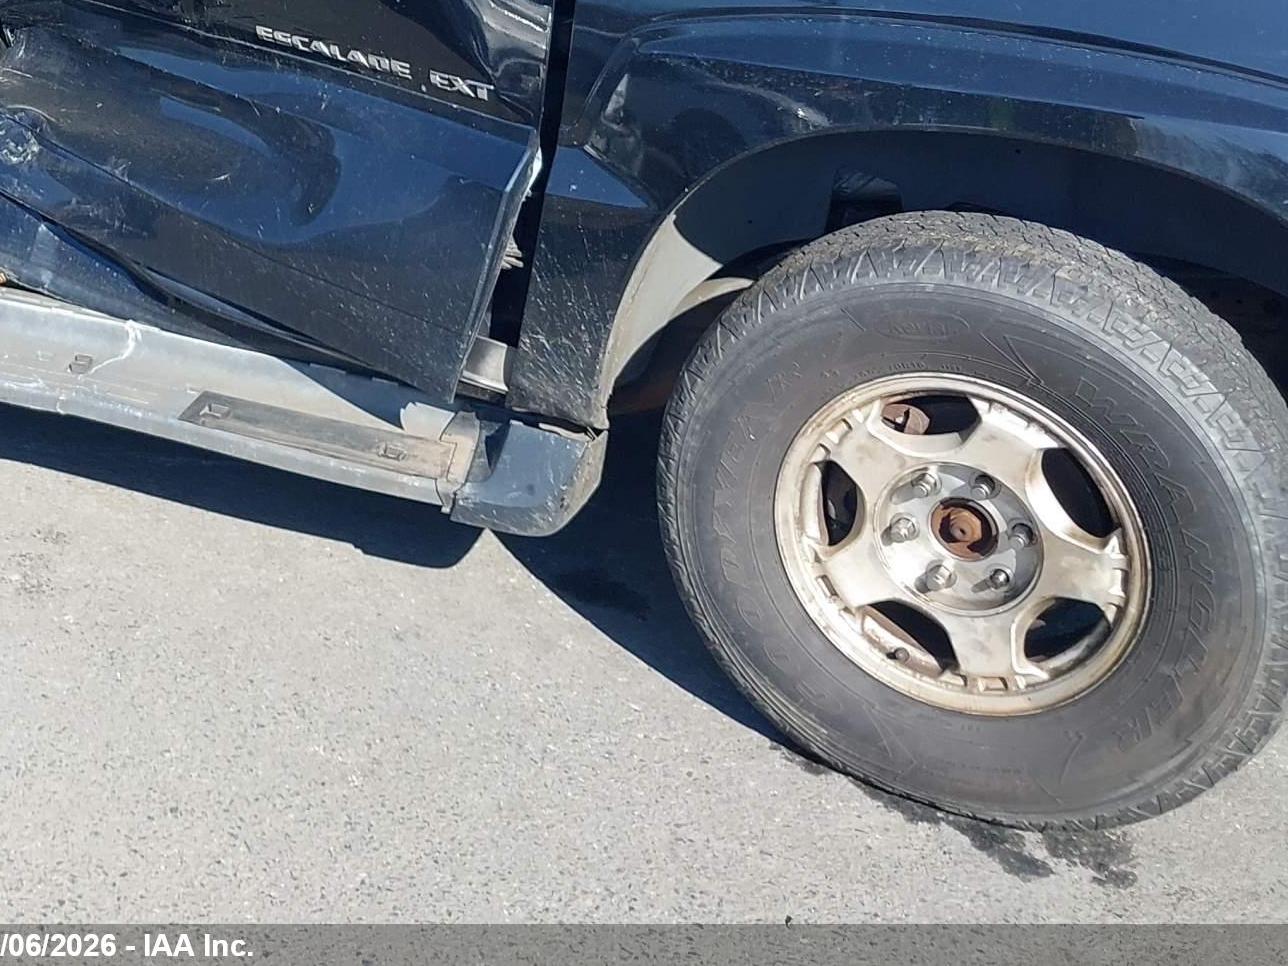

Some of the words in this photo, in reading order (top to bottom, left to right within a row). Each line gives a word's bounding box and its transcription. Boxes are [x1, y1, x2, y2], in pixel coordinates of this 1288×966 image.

[255, 25, 412, 80] ESCALADE
[429, 69, 495, 101] EXT
[1072, 376, 1216, 752] WRANGLER
